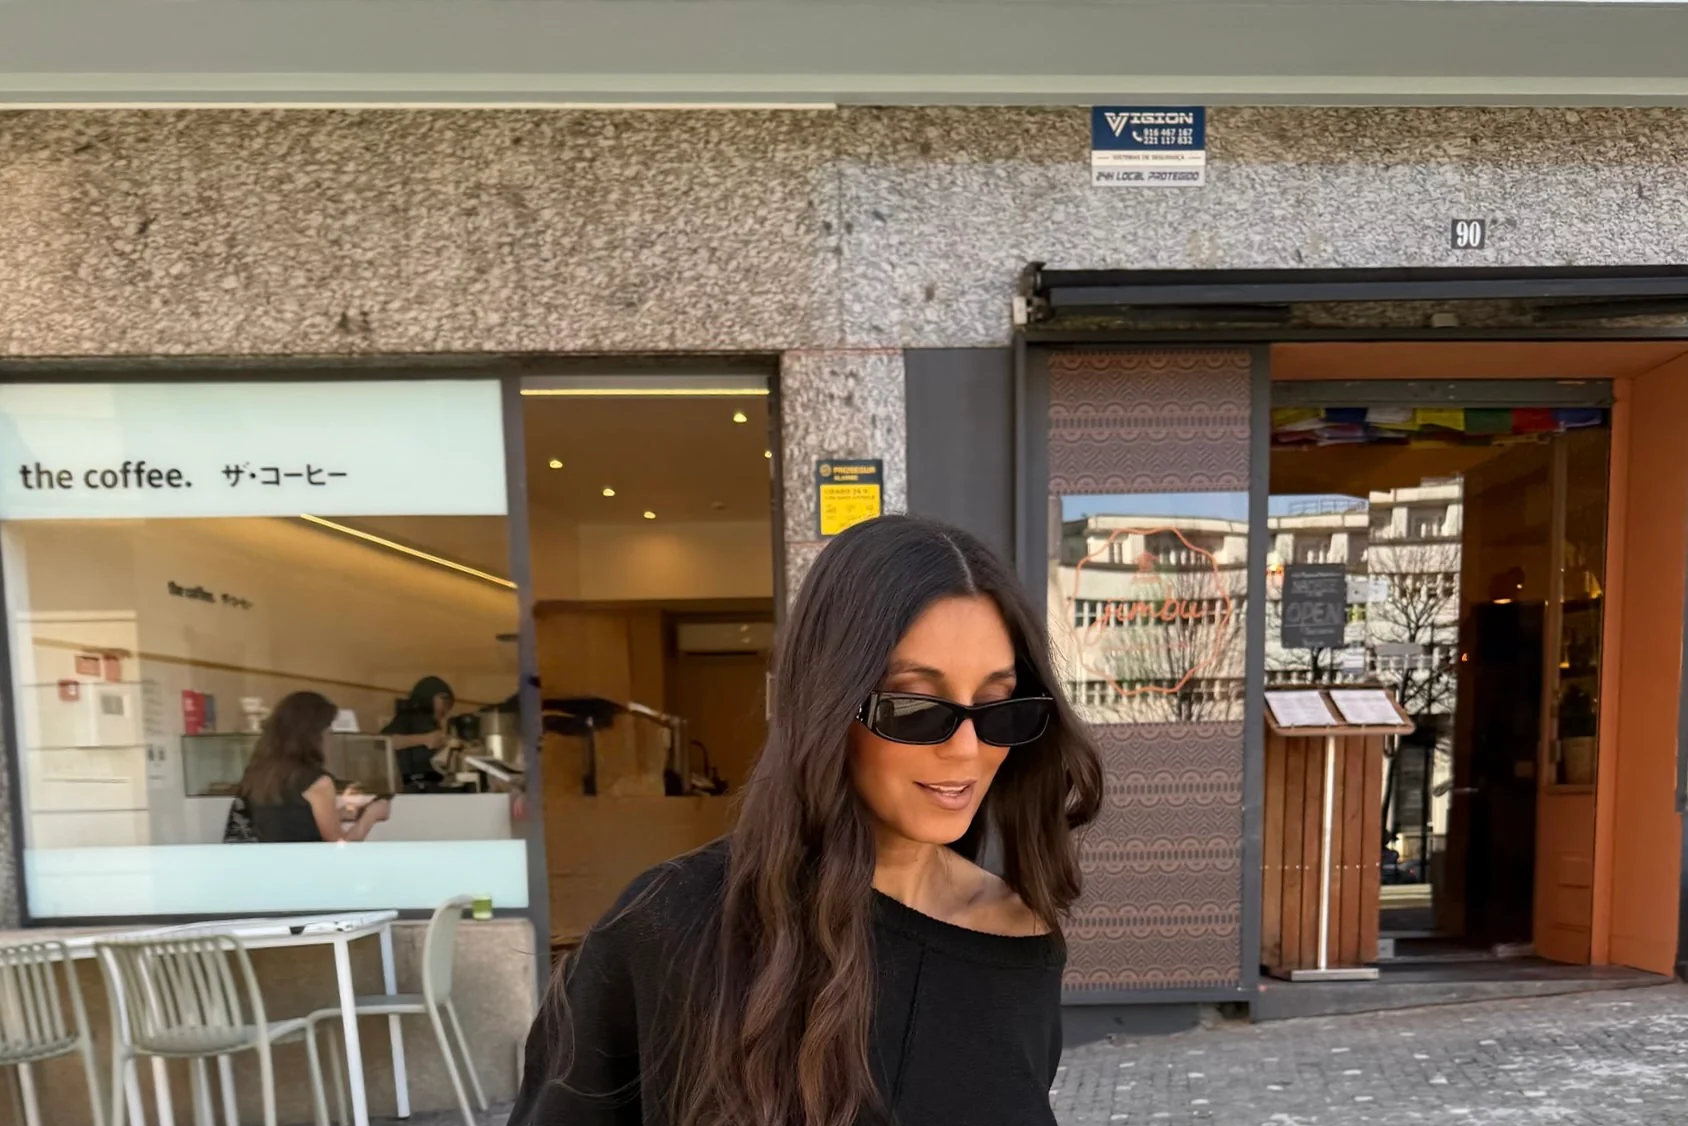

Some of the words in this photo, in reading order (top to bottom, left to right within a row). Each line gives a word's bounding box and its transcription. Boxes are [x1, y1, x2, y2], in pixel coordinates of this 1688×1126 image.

[1104, 112, 1194, 137] VISION
[1456, 221, 1481, 247] 90
[20, 462, 73, 489] the
[83, 461, 192, 489] coffee.
[1286, 602, 1343, 626] OPEN
